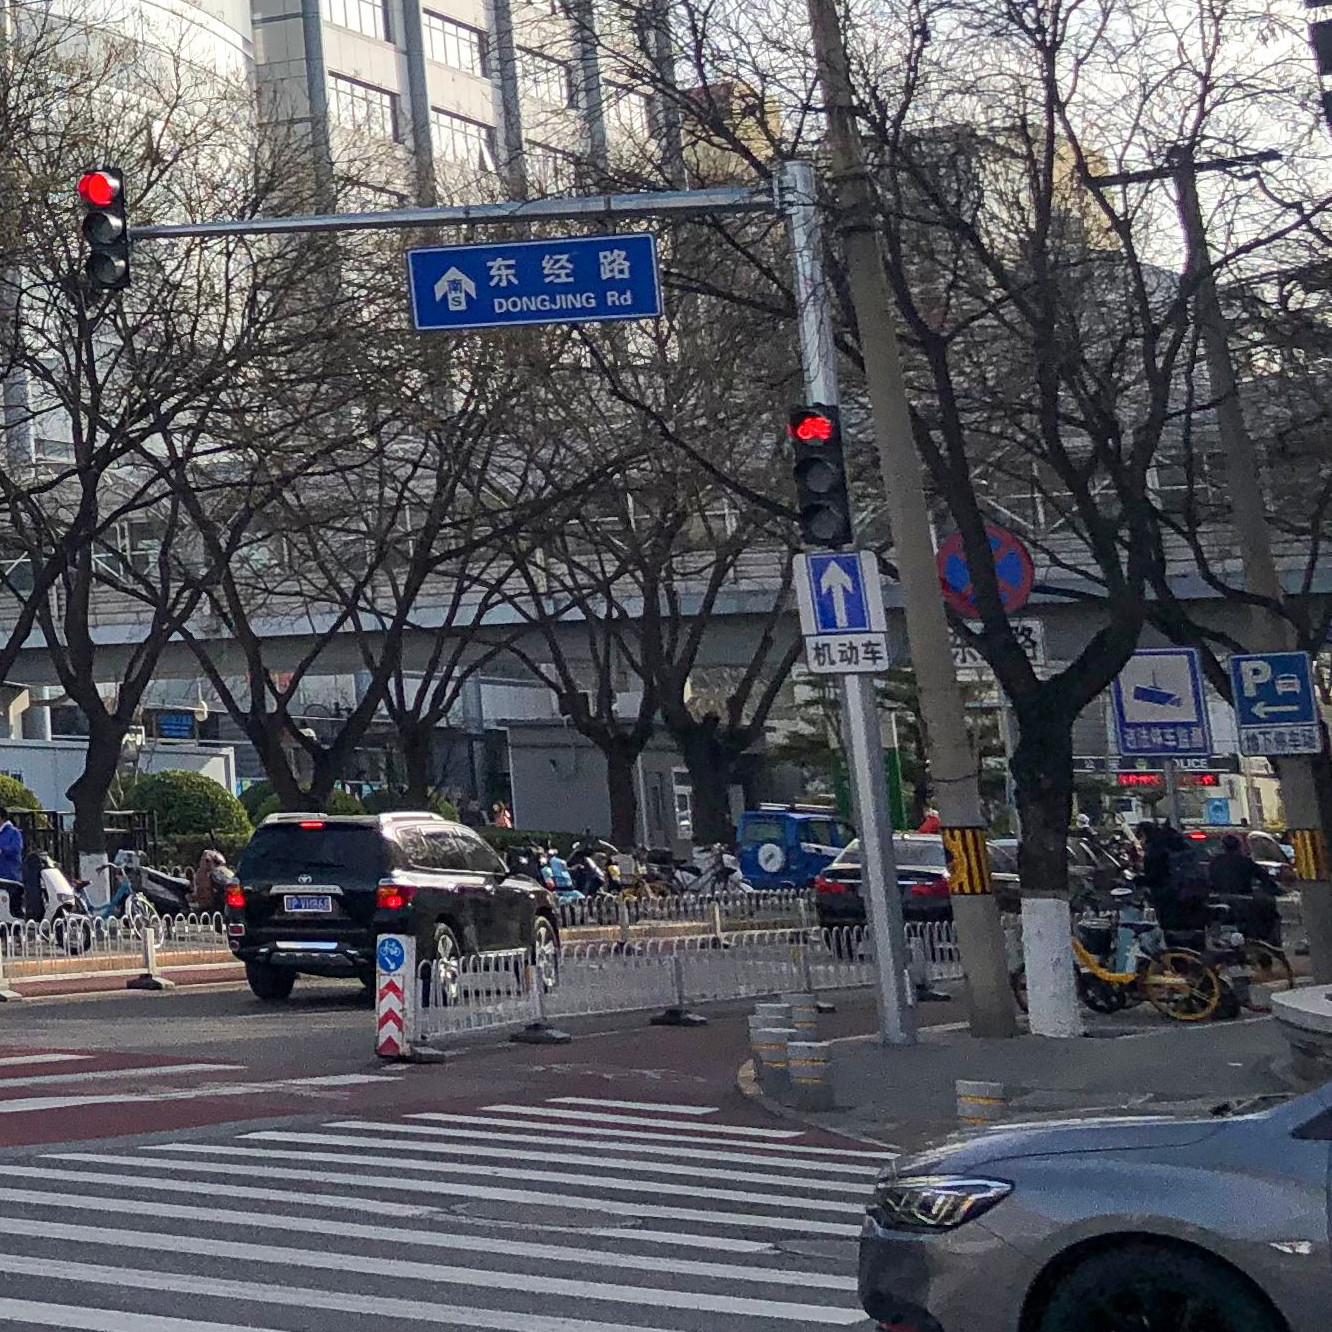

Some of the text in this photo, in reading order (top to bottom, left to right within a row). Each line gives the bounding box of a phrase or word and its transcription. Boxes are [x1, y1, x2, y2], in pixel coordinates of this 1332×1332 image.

[487, 249, 630, 287] 东经路
[451, 295, 462, 307] S
[493, 290, 633, 314] DONGJING Rd
[813, 640, 884, 666] 机动车
[1239, 660, 1272, 698] P
